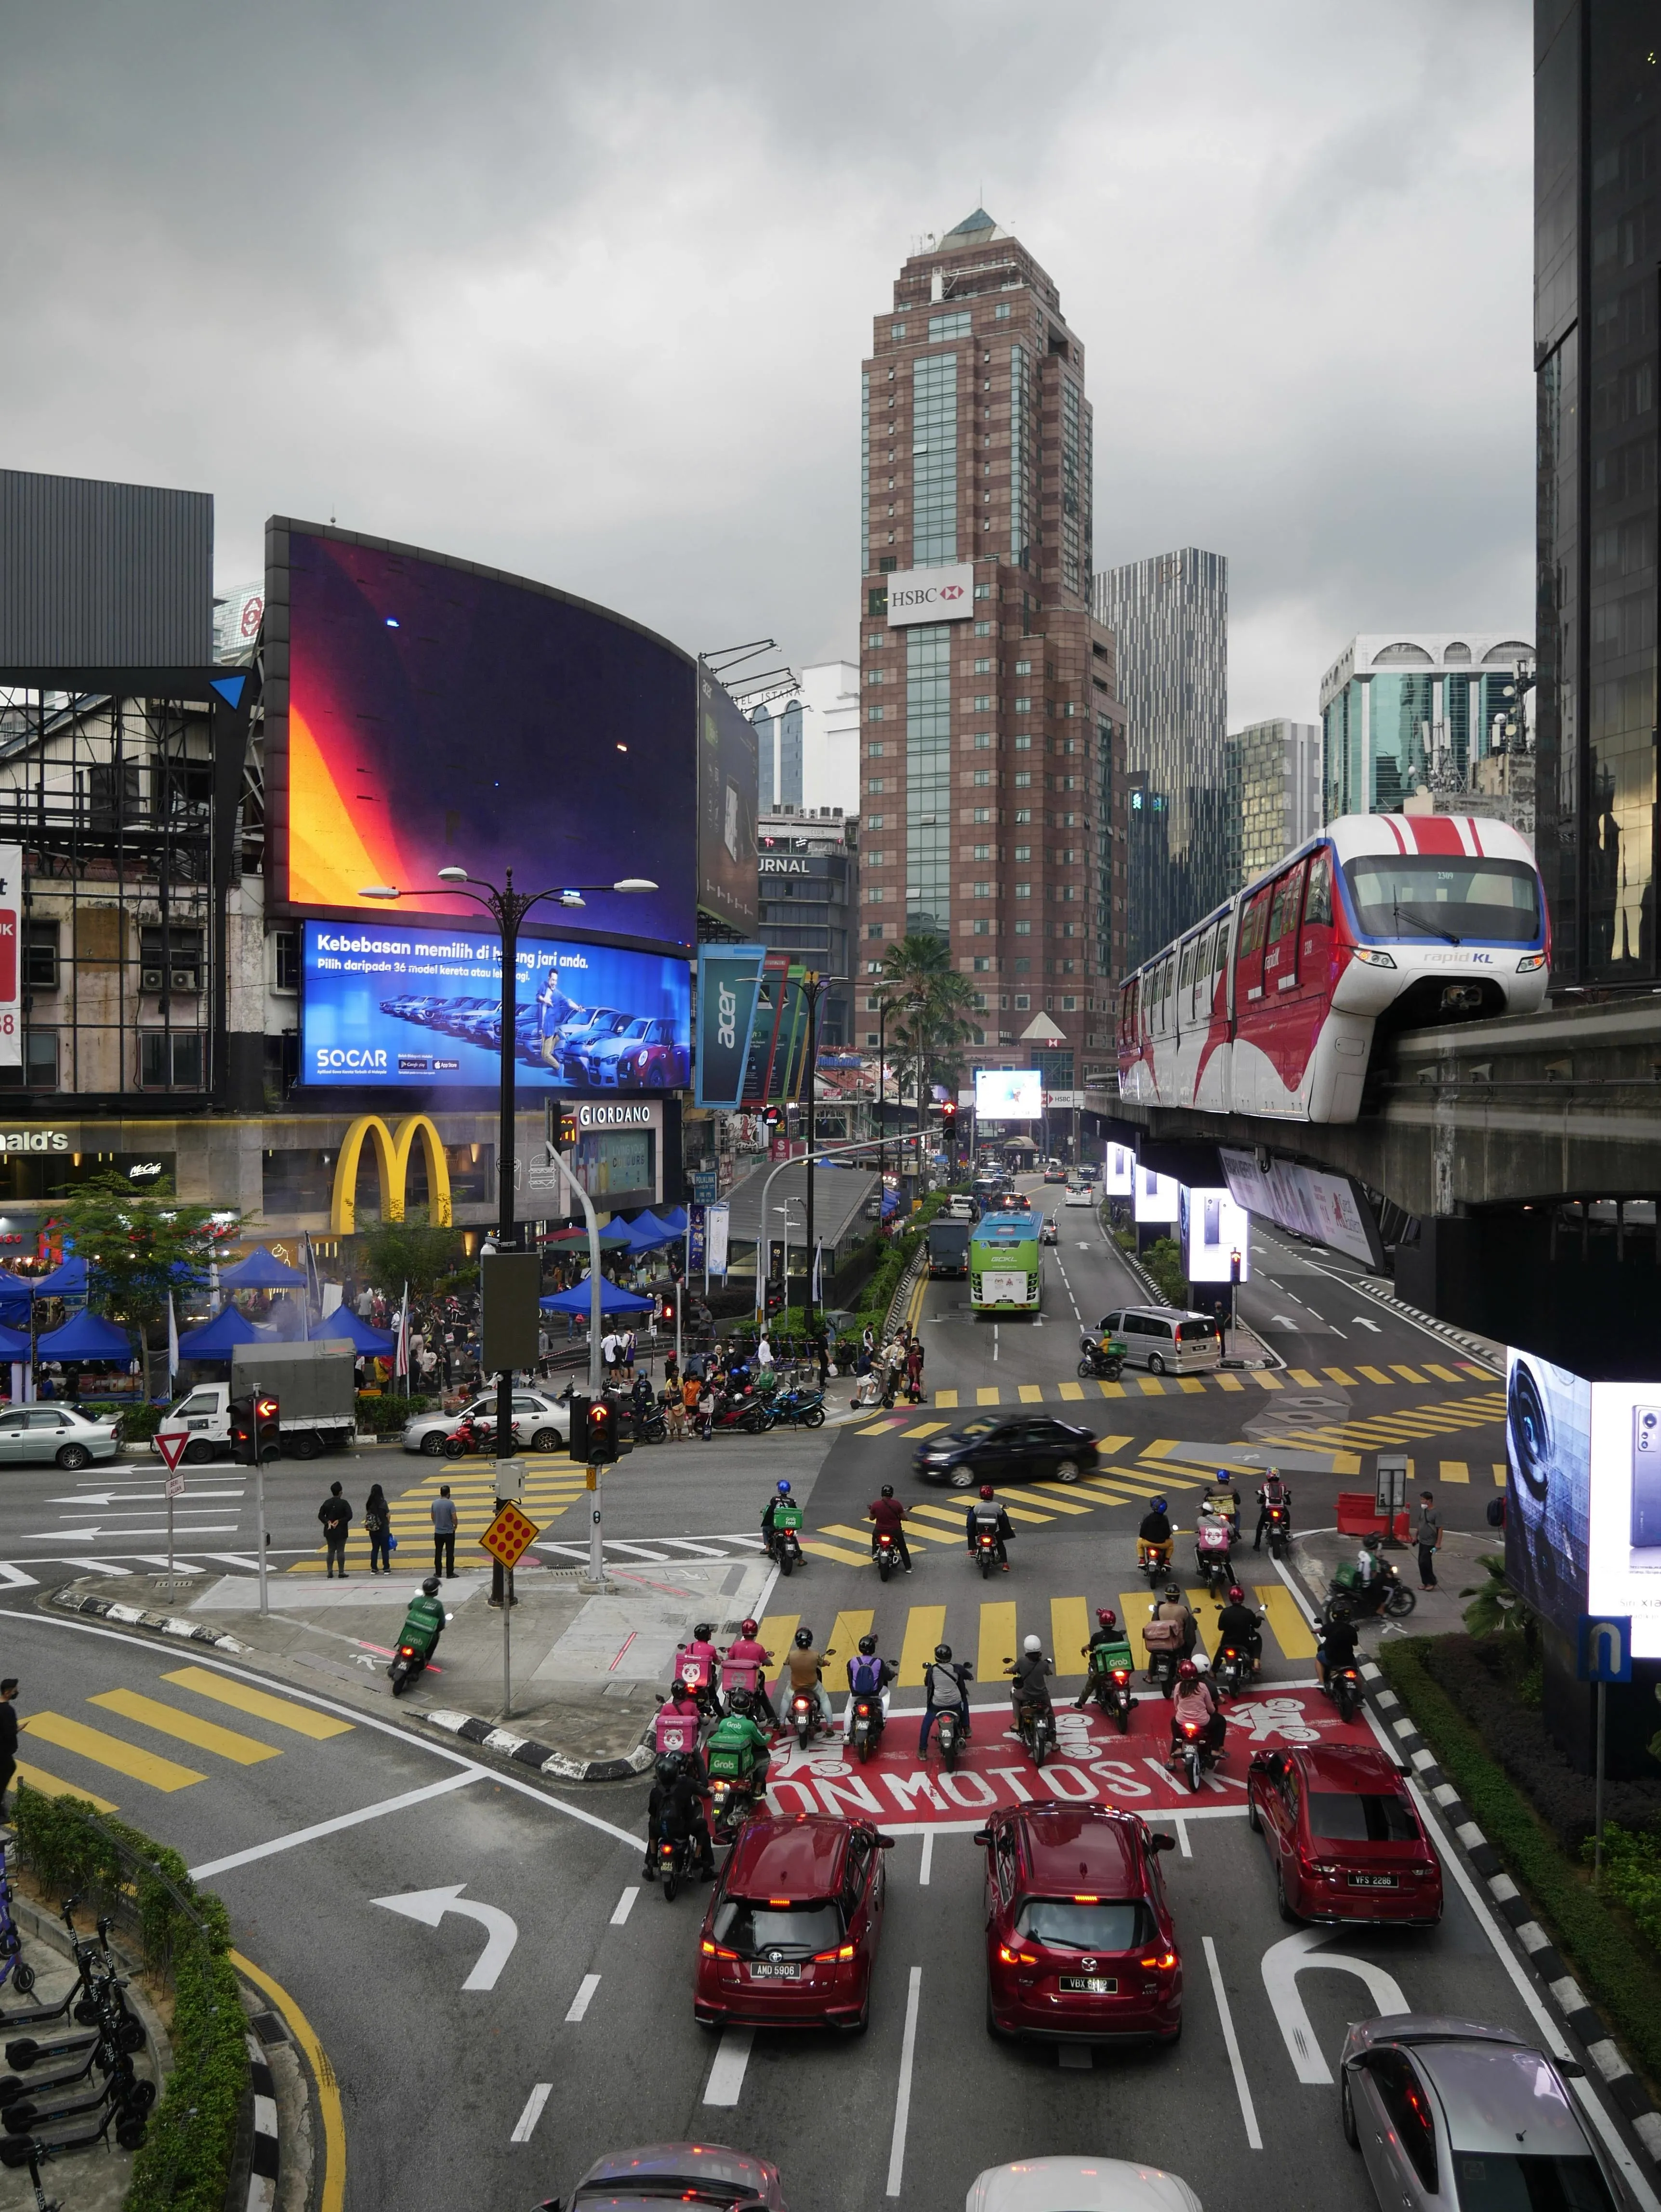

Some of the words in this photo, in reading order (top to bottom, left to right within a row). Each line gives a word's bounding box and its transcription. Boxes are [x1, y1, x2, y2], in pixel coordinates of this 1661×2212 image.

[1160, 559, 1183, 584] EQ
[892, 588, 937, 607] HSBC
[762, 689, 800, 701] ISTANA
[0, 924, 13, 935] K
[317, 935, 411, 955] Kebebasan
[415, 943, 473, 959] memilih
[476, 945, 489, 960] di
[537, 950, 557, 968] jari
[560, 954, 589, 969] anda.
[1424, 953, 1469, 964] rapid
[1472, 953, 1493, 964] KL
[318, 959, 342, 970] Pilih
[344, 960, 392, 974] daripada
[395, 962, 407, 973] 36
[409, 963, 438, 974] model
[440, 965, 469, 977] kereta
[471, 968, 491, 978] atau
[718, 981, 736, 1049] acer
[0, 1014, 14, 1035] 8
[317, 1049, 387, 1067] SOCAR
[580, 1105, 650, 1126] GIORDANO
[613, 1155, 645, 1168] COLOURS
[170, 1480, 179, 1488] BERI
[406, 1634, 423, 1646] Grab
[1109, 1659, 1128, 1667] Grab
[726, 1721, 741, 1729] Grab
[714, 1760, 734, 1769] Grab
[1356, 1876, 1369, 1884] VFS
[1373, 1876, 1391, 1885] 2286
[69, 1928, 78, 1947] ZEUS
[104, 1950, 113, 1969] ZEUS
[757, 1965, 773, 1975] AMD
[774, 1966, 795, 1975] 5906
[1070, 1978, 1085, 1988] VBX
[89, 1985, 98, 2002] ZEUS
[105, 2042, 115, 2062] ZEUS
[35, 2187, 44, 2210] ZEUS
